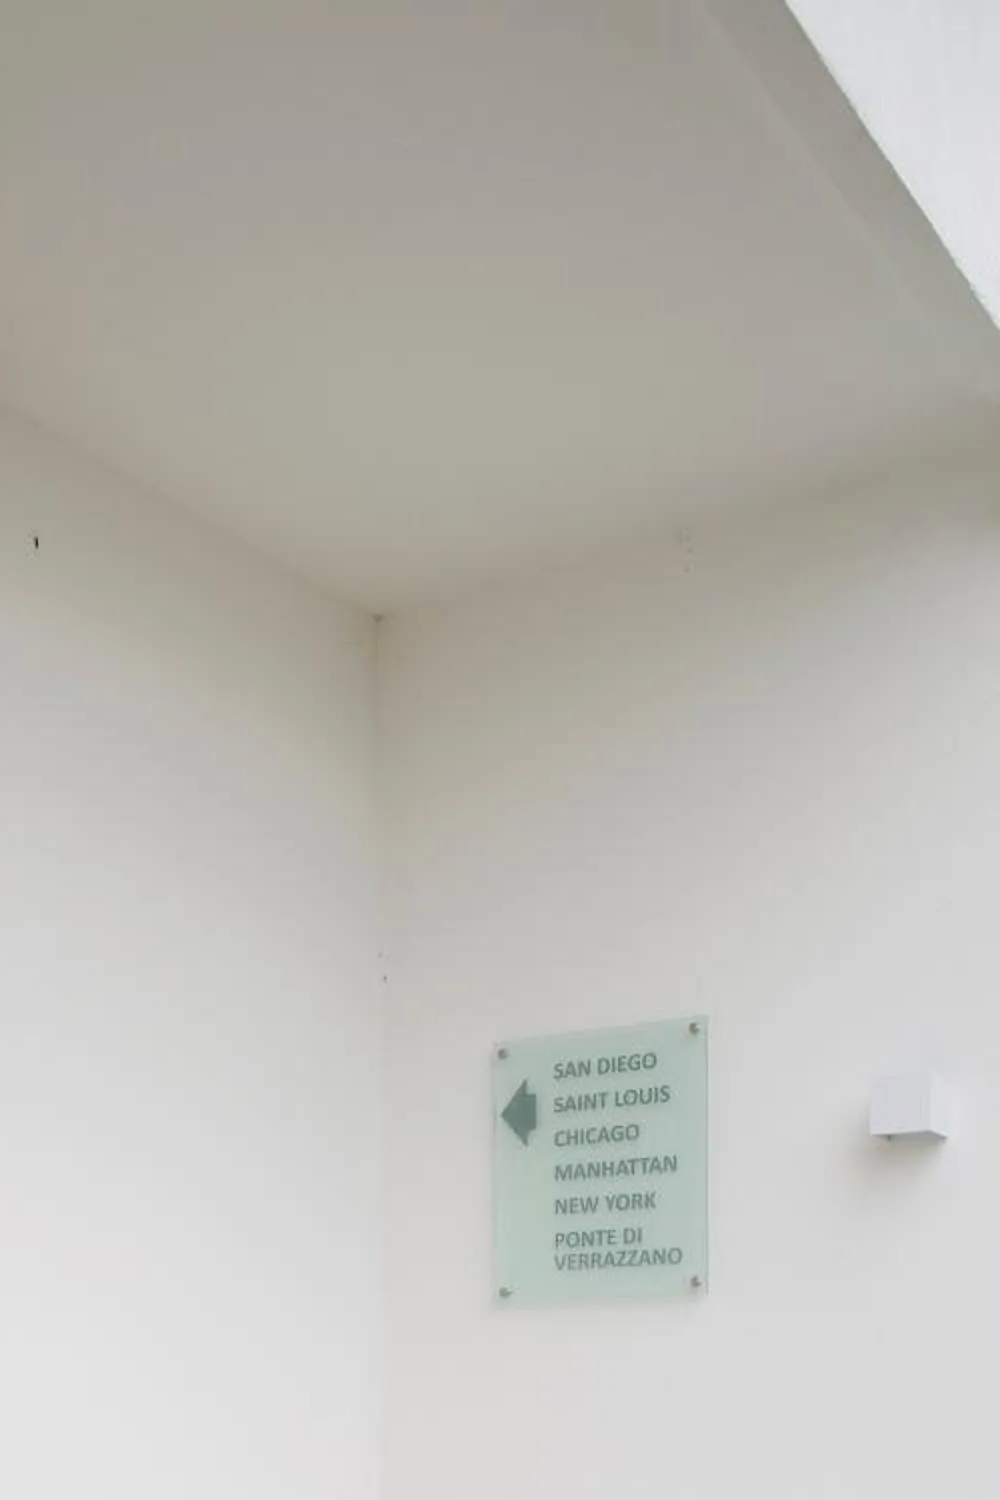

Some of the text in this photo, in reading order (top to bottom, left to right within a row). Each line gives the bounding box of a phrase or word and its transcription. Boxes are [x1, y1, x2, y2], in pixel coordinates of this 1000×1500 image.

[553, 1053, 657, 1080] SAN DIEGO
[553, 1085, 671, 1113] SAINT LOUIS
[554, 1124, 640, 1147] CHICAGO
[554, 1155, 678, 1181] MANHATTAN
[554, 1191, 657, 1215] NEW YORK
[555, 1227, 643, 1249] PONTE DI
[554, 1247, 682, 1271] VERRAZZANO
